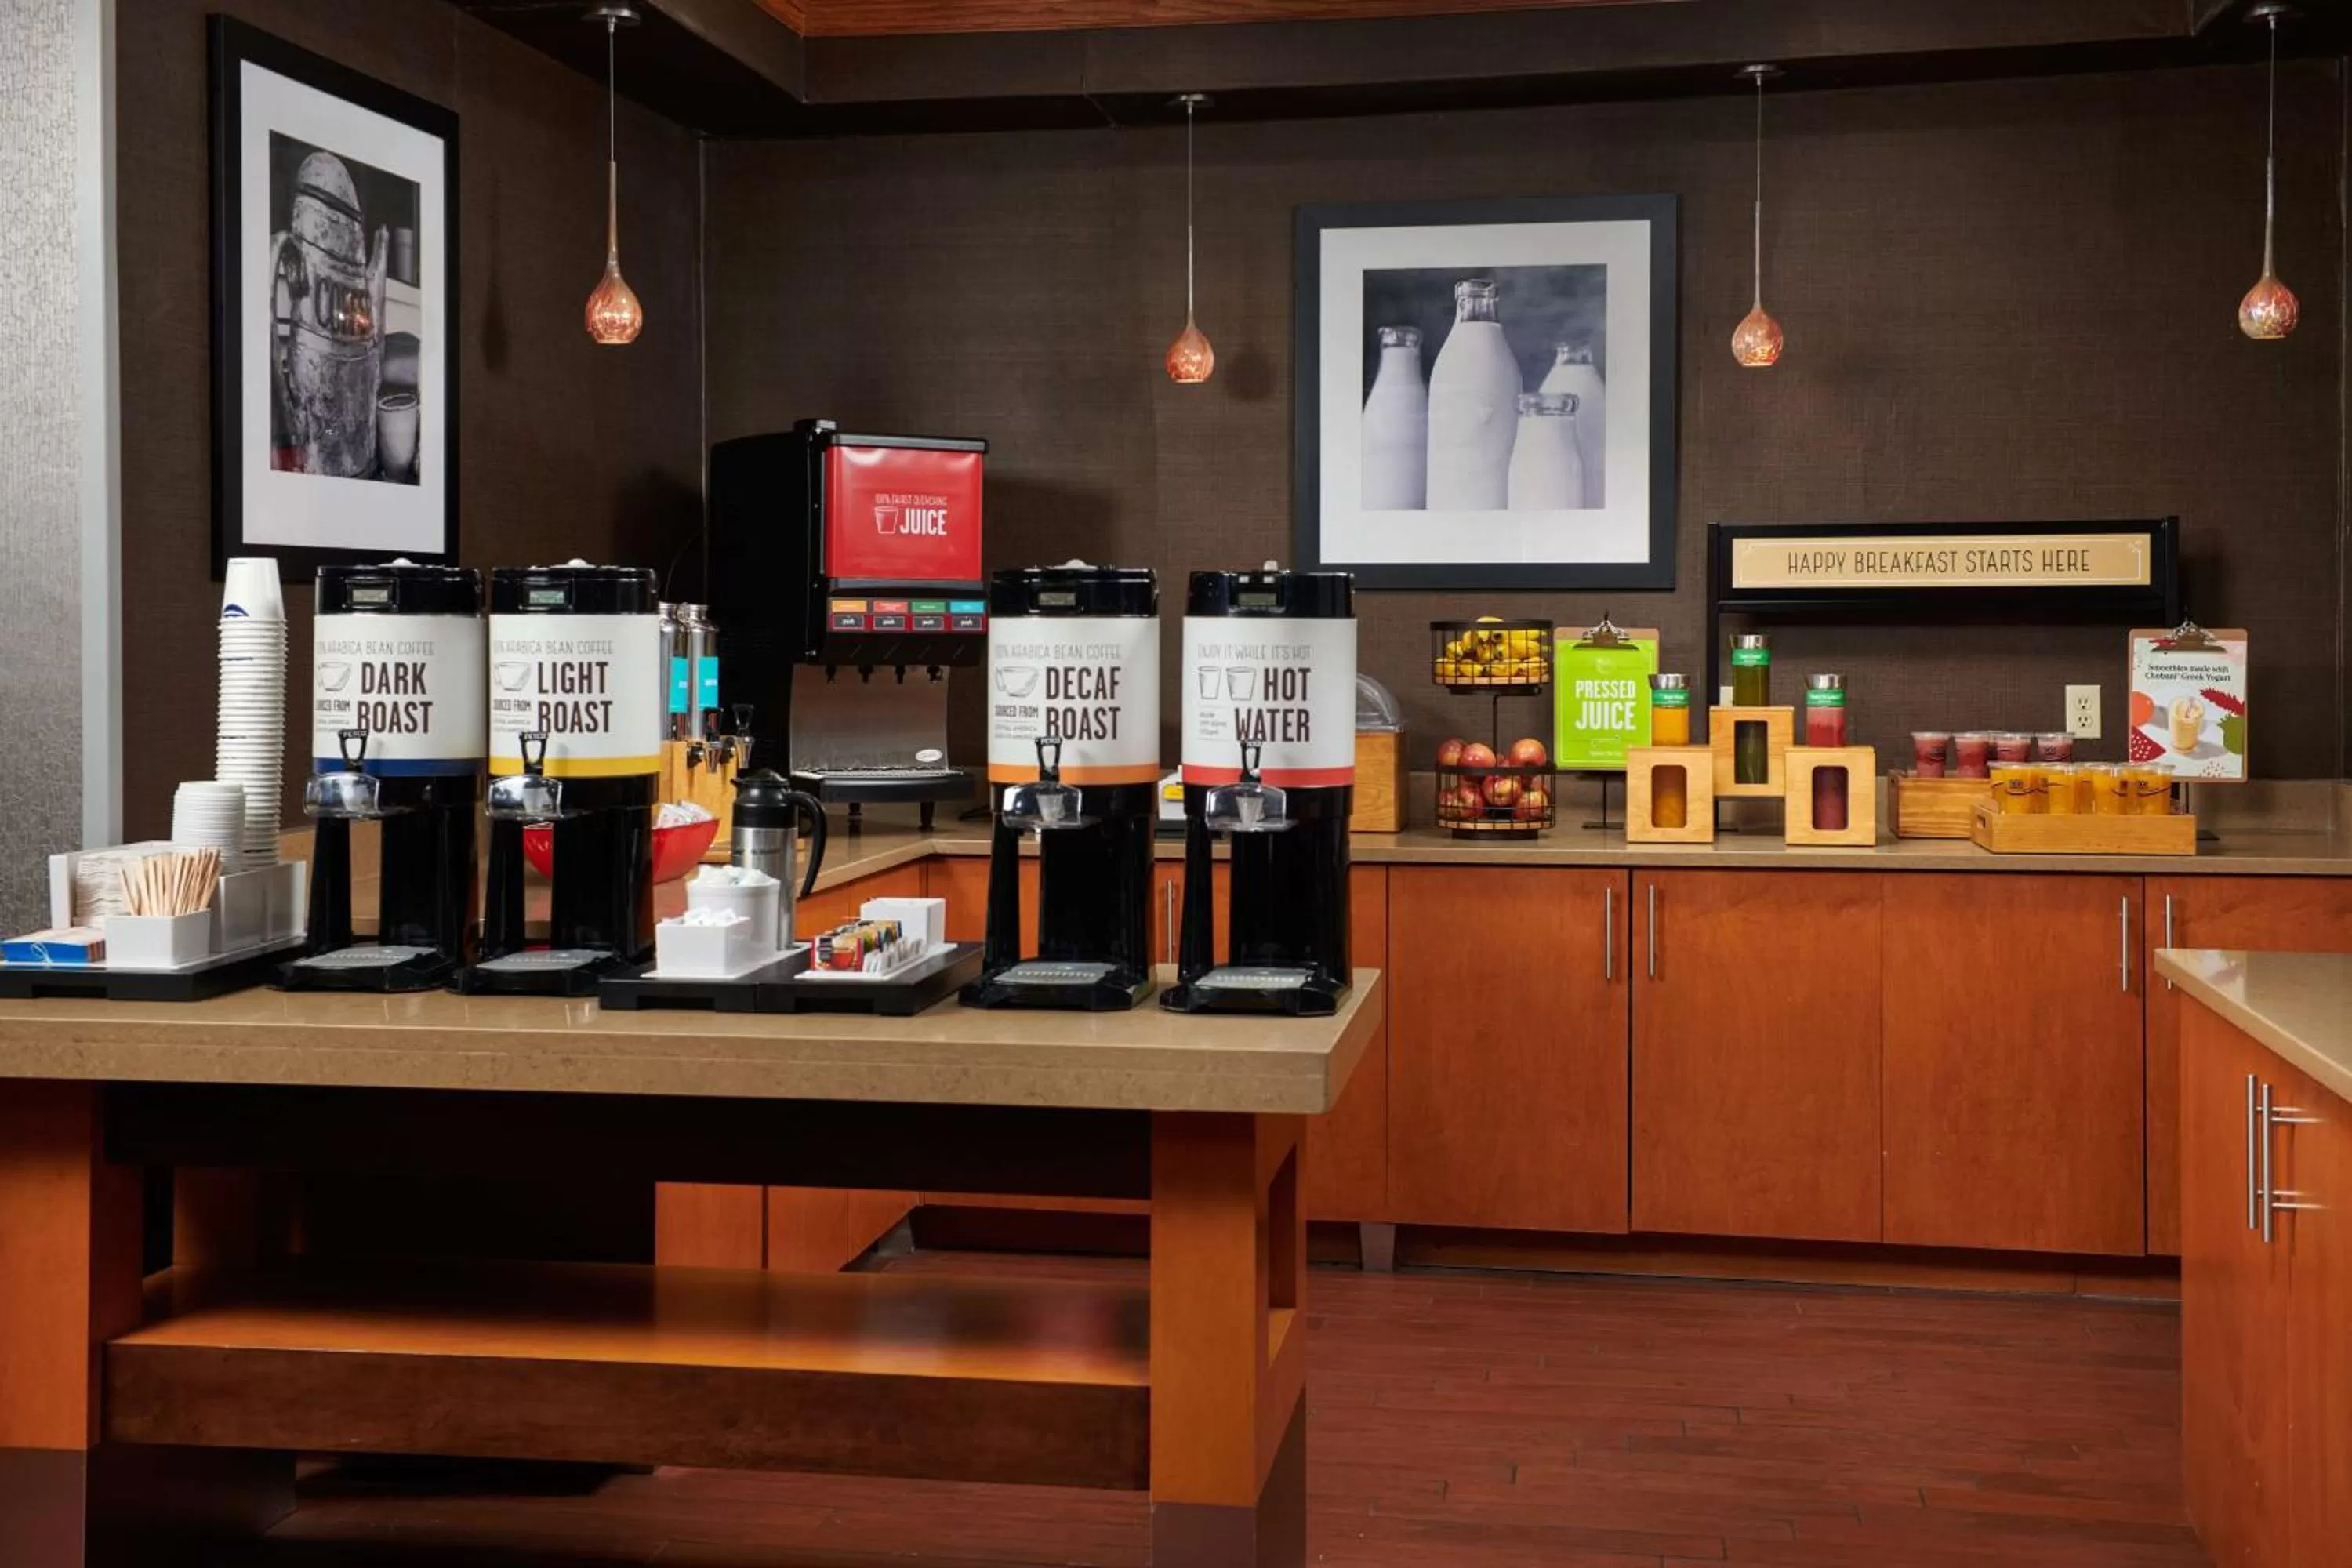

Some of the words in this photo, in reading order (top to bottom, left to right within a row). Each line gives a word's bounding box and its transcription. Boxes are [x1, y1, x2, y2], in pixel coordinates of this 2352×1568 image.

[900, 508, 947, 535] JUICE
[1788, 551, 1846, 574] HAPPY
[1854, 550, 1958, 574] BREAKFAST
[1965, 550, 2033, 573] STARTS
[2042, 550, 2090, 572] HERE
[366, 640, 394, 655] BEAN
[397, 640, 436, 656] COFFEE
[546, 640, 573, 655] BEAN
[576, 640, 615, 655] COFFEE
[1054, 644, 1082, 659] BEAN
[1086, 644, 1123, 660] COFFEE
[1235, 643, 1267, 660] WHILE
[361, 662, 427, 695] DARK
[538, 661, 609, 694] LIGHT
[2180, 672, 2204, 681] Greek
[2205, 673, 2231, 682] Yogurt
[2212, 664, 2229, 673] with
[1046, 666, 1122, 700] DECAF
[1264, 667, 1311, 701] HOT
[1575, 680, 1637, 699] PRESSED
[357, 700, 433, 734] ROAST
[538, 700, 613, 734] ROAST
[1018, 705, 1039, 717] FROM
[1046, 706, 1122, 740] ROAST
[1234, 707, 1310, 742] WATER
[1575, 702, 1637, 730] JUICE
